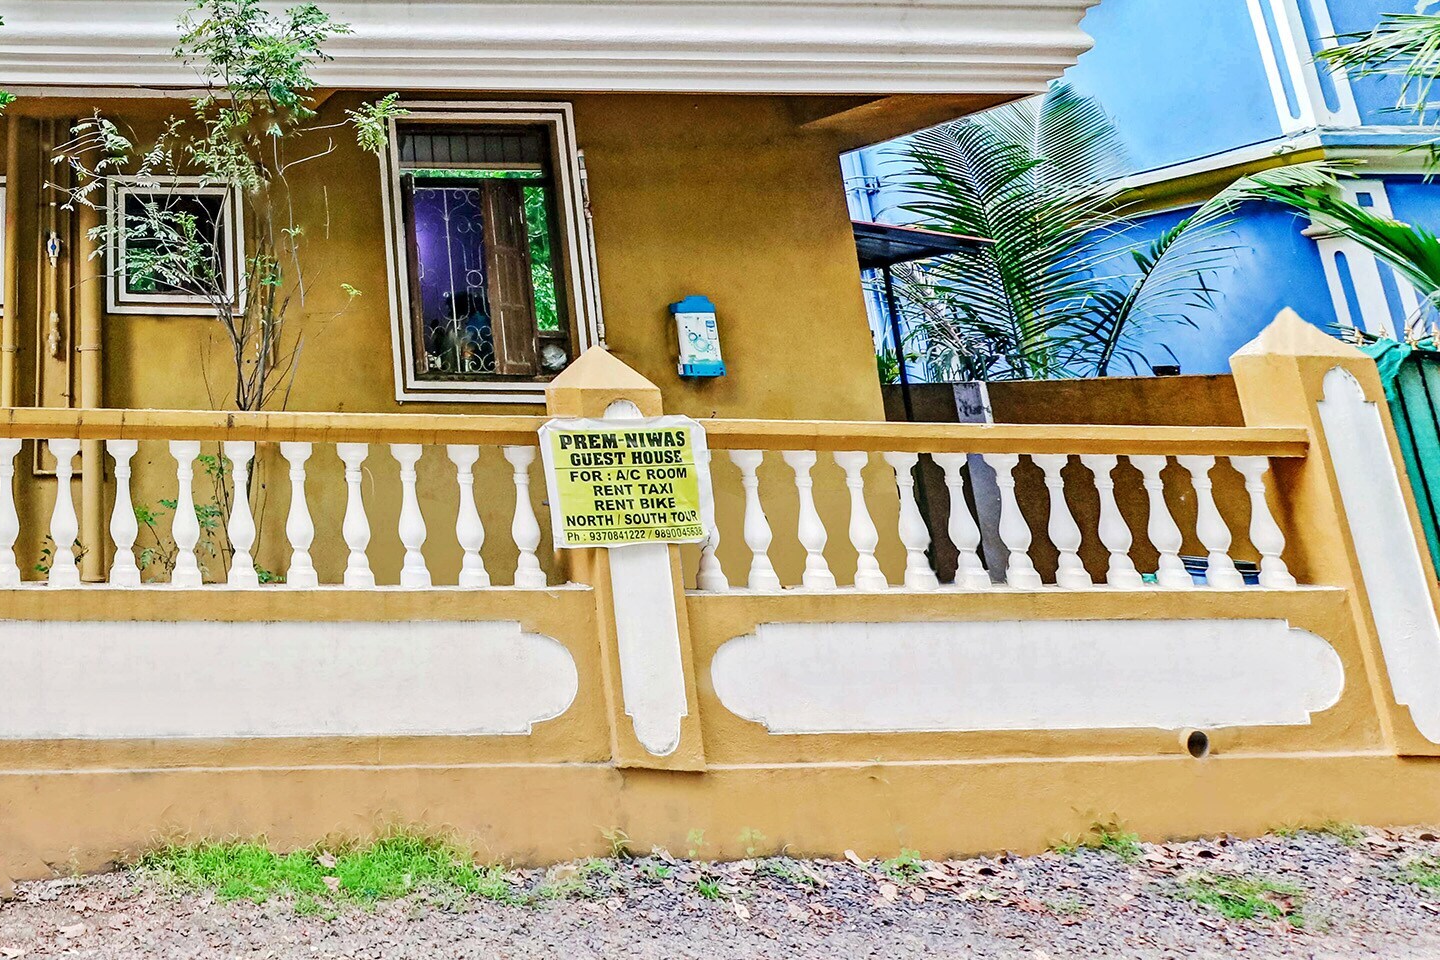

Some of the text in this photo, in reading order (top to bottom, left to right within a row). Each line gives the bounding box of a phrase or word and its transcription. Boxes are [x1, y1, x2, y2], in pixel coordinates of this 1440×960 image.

[559, 431, 686, 450] PREM-NIWAS
[570, 450, 683, 466] GUEST HOUSE
[570, 471, 603, 482] FOR
[616, 469, 641, 481] A/C
[646, 467, 687, 480] ROOM
[593, 483, 673, 496] RENT TAXI
[594, 497, 676, 511] RENT BIKE
[566, 515, 614, 527] NORTH
[624, 513, 667, 525] SOUTH
[671, 510, 698, 522] TOUR
[567, 532, 580, 541] Ph
[589, 530, 646, 541] 9370841222
